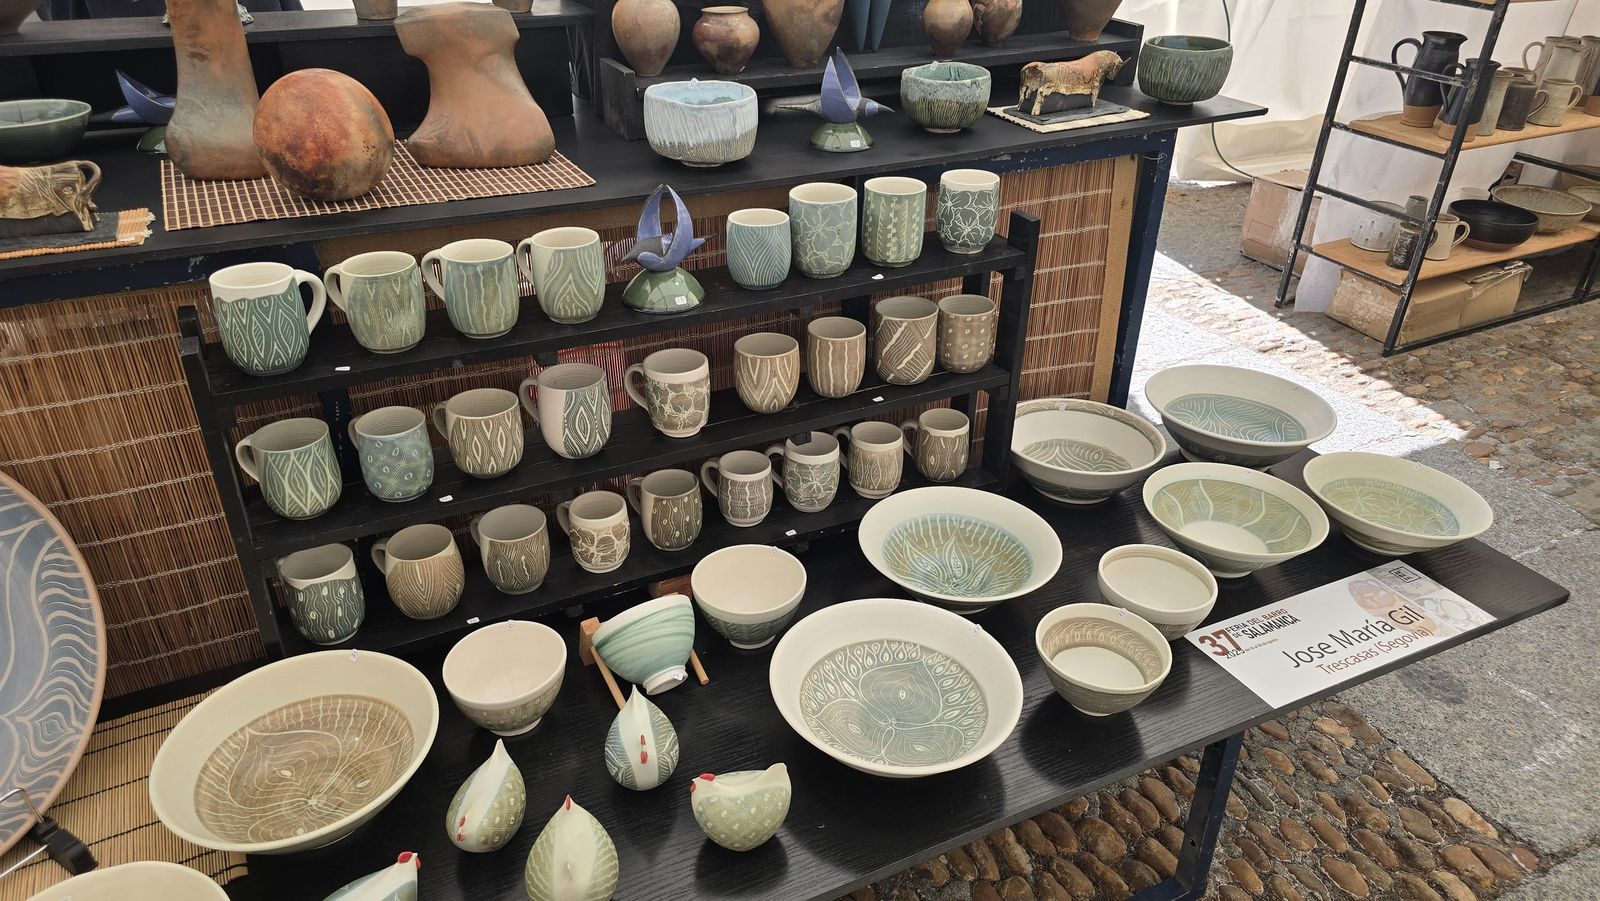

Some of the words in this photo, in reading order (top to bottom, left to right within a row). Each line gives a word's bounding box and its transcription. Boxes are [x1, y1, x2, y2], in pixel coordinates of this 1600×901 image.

[1225, 623, 1248, 633] FERIA
[1247, 617, 1262, 626] DEL
[1261, 608, 1288, 621] BARRO
[1232, 631, 1243, 639] DE
[1241, 614, 1301, 639] SALAMANCA
[1198, 629, 1242, 657] 37
[1282, 641, 1337, 668] Jose
[1328, 619, 1396, 649] María
[1388, 604, 1425, 625] Gil
[1316, 648, 1379, 676] Trescasas
[1376, 626, 1433, 655] (Segovia)
